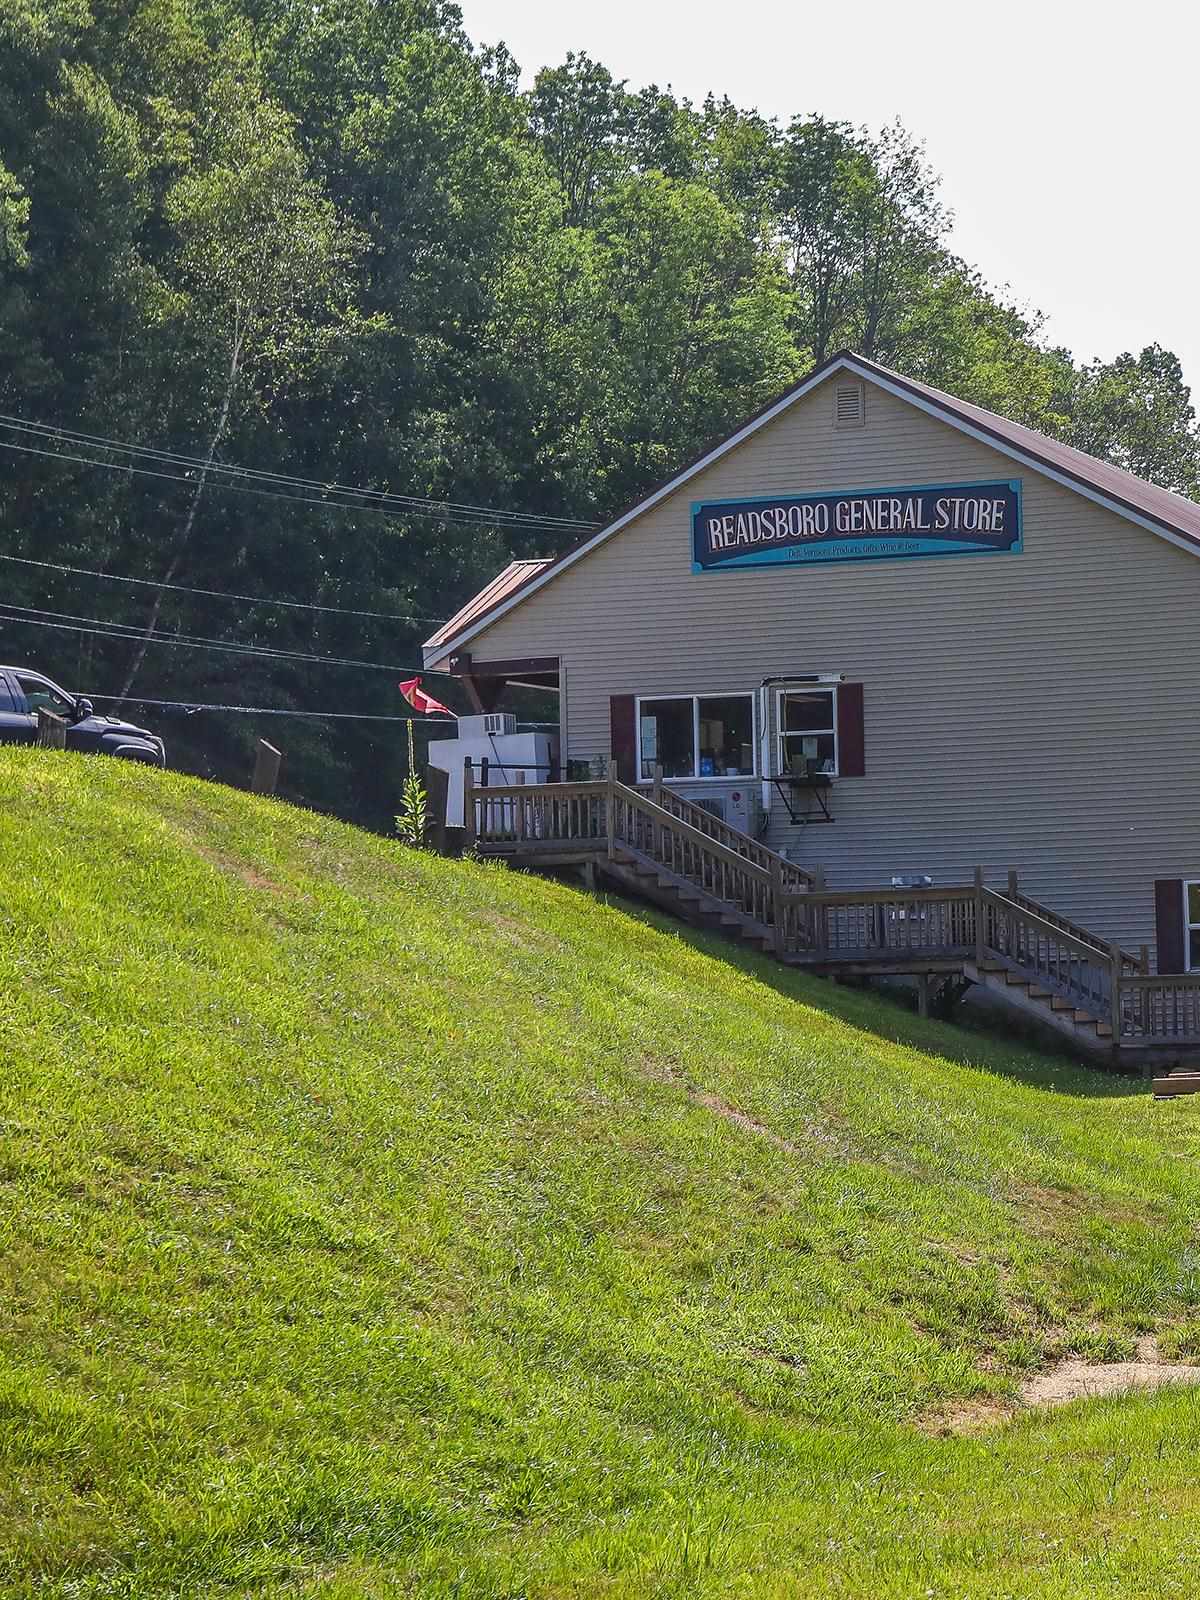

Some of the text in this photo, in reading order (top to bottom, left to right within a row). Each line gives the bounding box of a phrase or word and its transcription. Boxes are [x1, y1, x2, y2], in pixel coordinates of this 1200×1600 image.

[708, 498, 1006, 549] READSBORO GENERAL STORE
